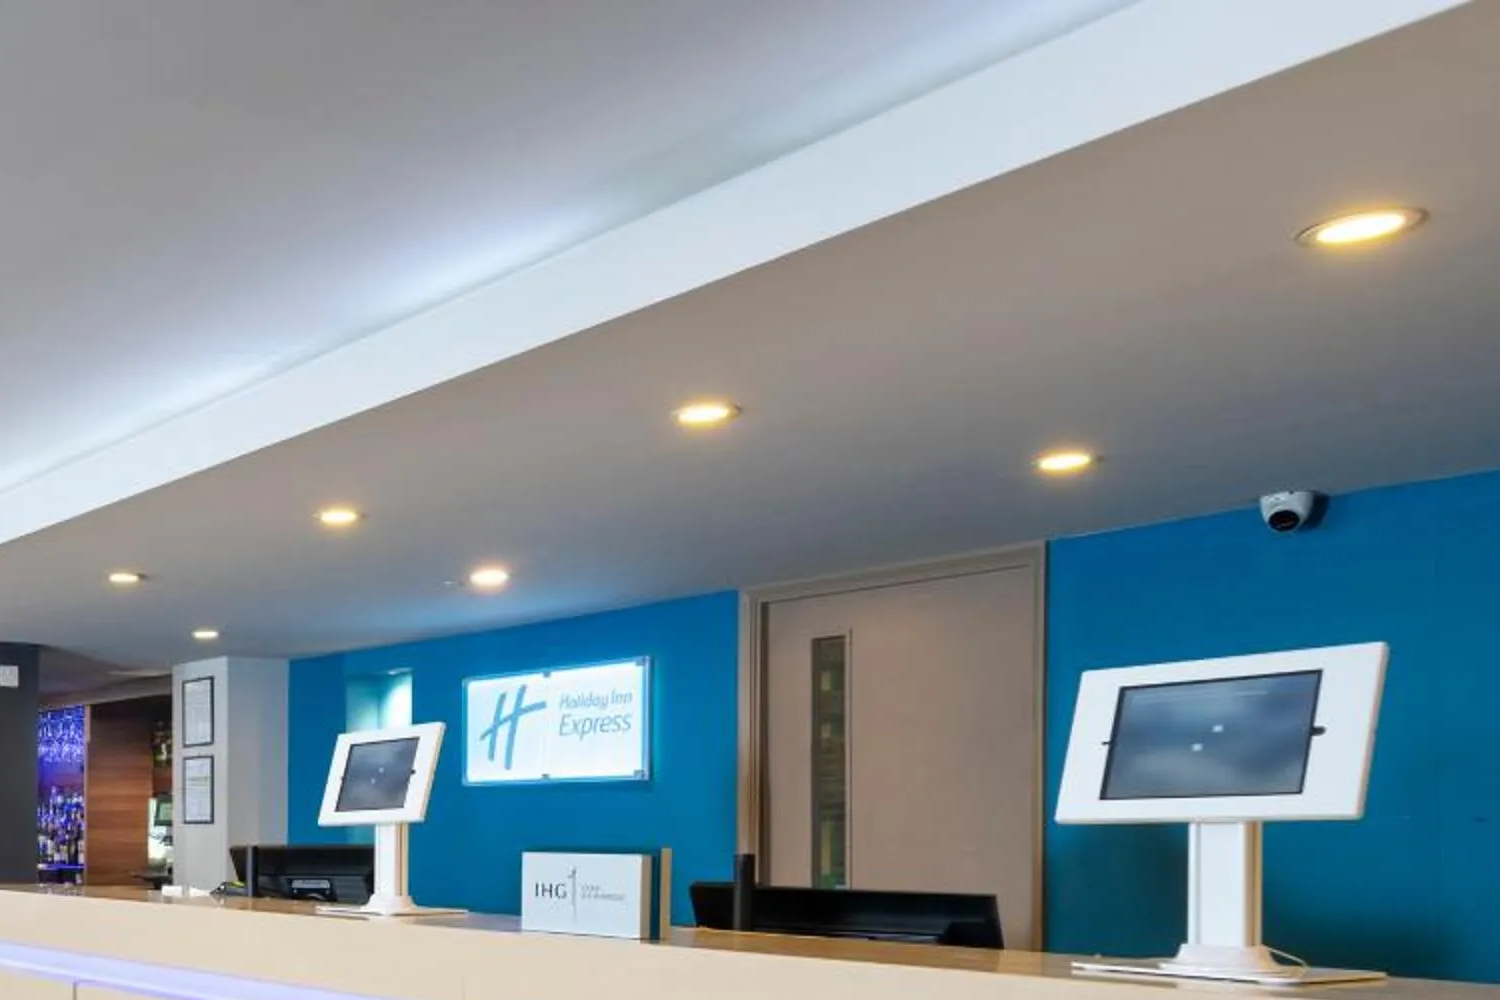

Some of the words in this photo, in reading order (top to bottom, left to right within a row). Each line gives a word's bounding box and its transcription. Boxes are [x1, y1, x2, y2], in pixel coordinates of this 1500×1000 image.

[559, 692, 609, 711] Holiday
[611, 687, 633, 705] Inn
[559, 713, 632, 742] Express
[534, 882, 567, 899] IHG
